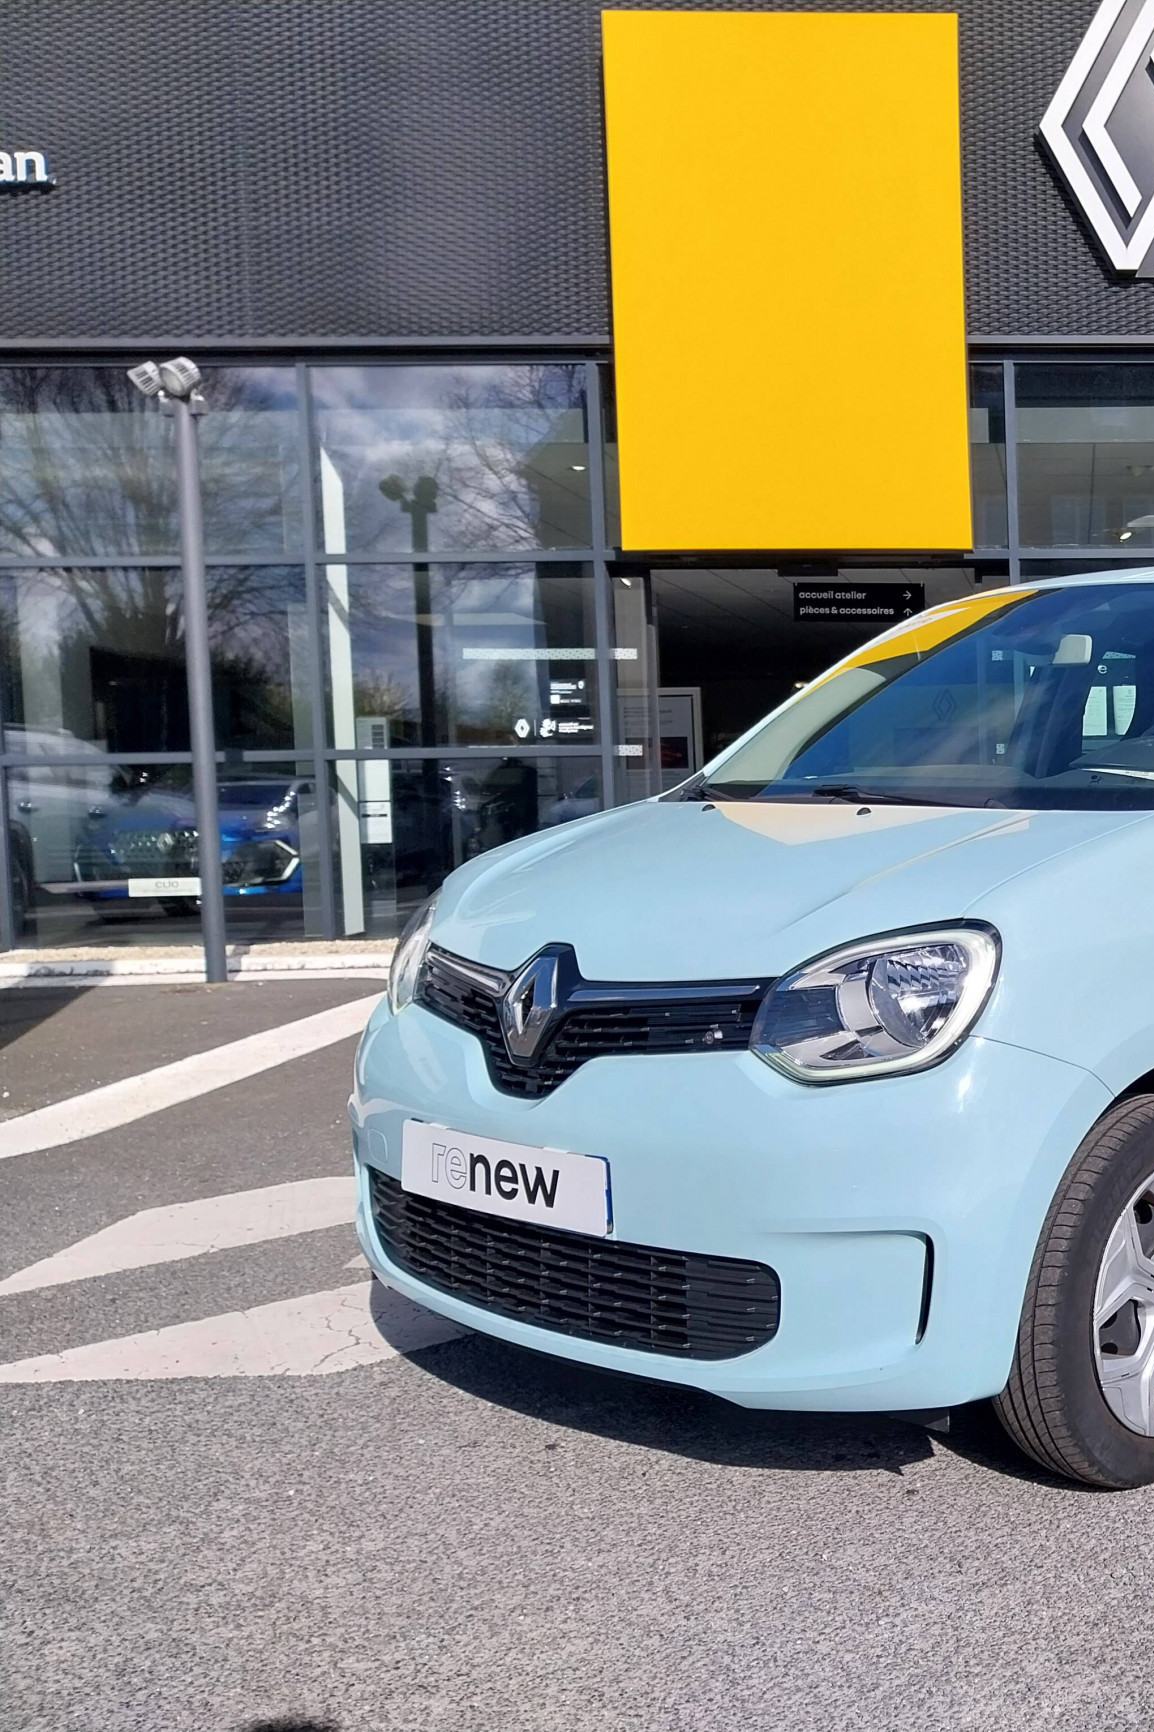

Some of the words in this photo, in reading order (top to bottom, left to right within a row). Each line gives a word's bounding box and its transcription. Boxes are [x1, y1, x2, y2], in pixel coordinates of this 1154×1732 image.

[798, 591, 834, 599] accueil
[835, 591, 867, 600] atelier
[799, 606, 830, 616] pièces
[831, 606, 838, 615] &
[839, 606, 895, 615] accessoires
[154, 880, 180, 889] CLIO
[431, 1142, 560, 1209] renew
